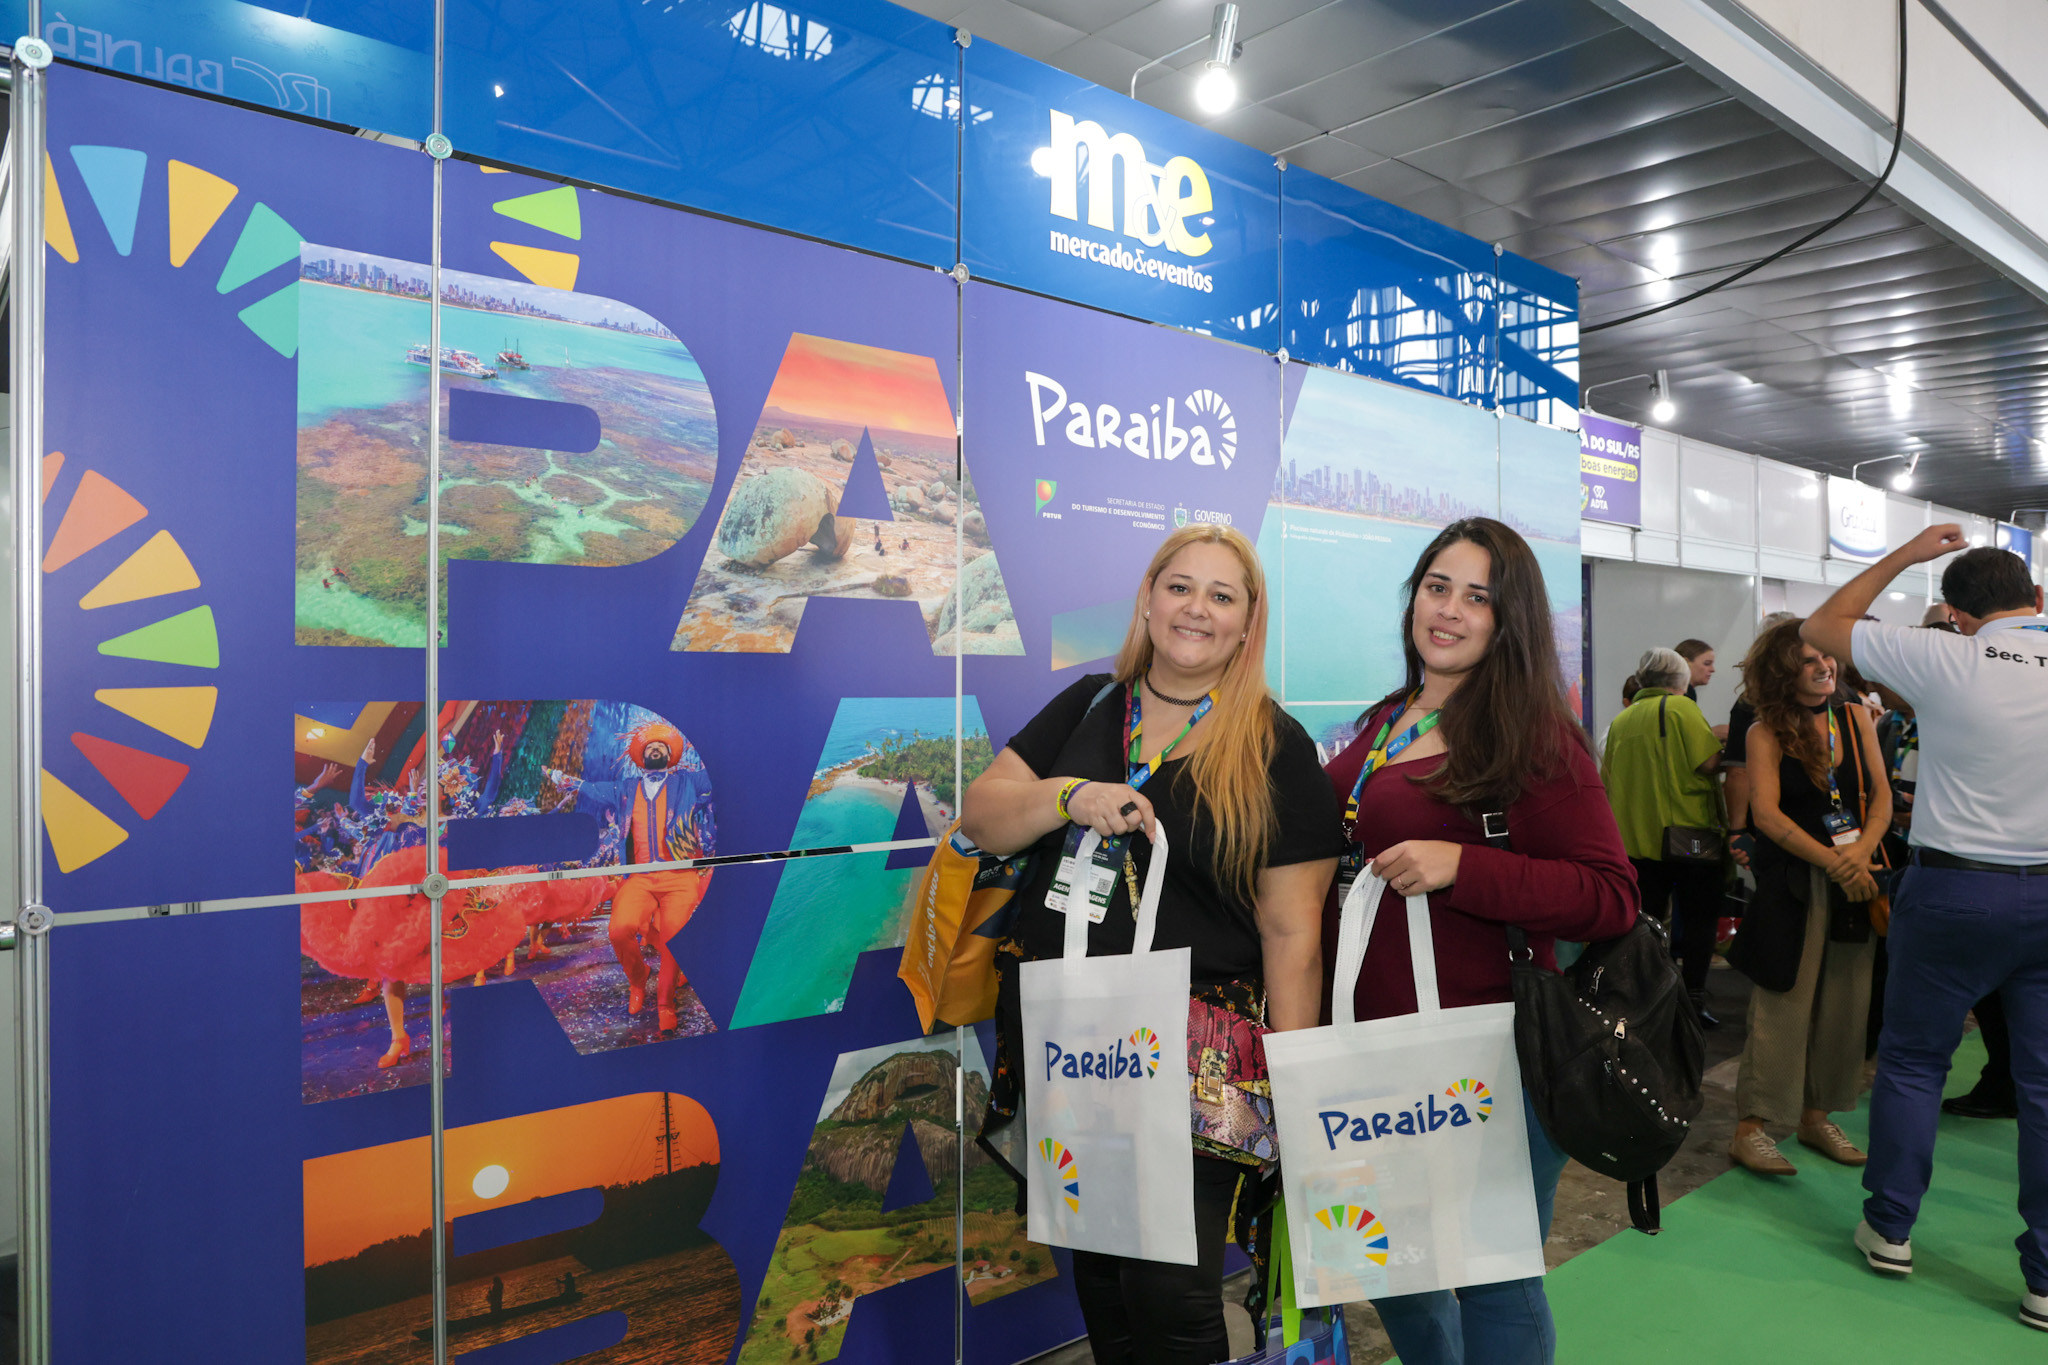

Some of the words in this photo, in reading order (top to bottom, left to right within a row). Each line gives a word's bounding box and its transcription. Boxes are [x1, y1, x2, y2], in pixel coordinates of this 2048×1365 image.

[1050, 230, 1214, 294] mercado&eventos
[1590, 434, 1606, 452] DO
[1606, 438, 1641, 460] SUL/RS
[1581, 456, 1602, 471] boas
[1603, 463, 1638, 480] energias
[1071, 503, 1081, 511] DO
[1082, 503, 1108, 514] TURISMO
[1113, 508, 1166, 521] DESENVOLVIMENTO
[1106, 497, 1137, 508] SECRETARIA
[1146, 502, 1166, 511] ESTADO
[1590, 498, 1609, 511] ADTA
[1042, 511, 1062, 520] PBTUR
[1194, 509, 1233, 525] GOVERNO
[1132, 520, 1166, 531] ECONÔMICO
[1985, 646, 2029, 665] Sec.
